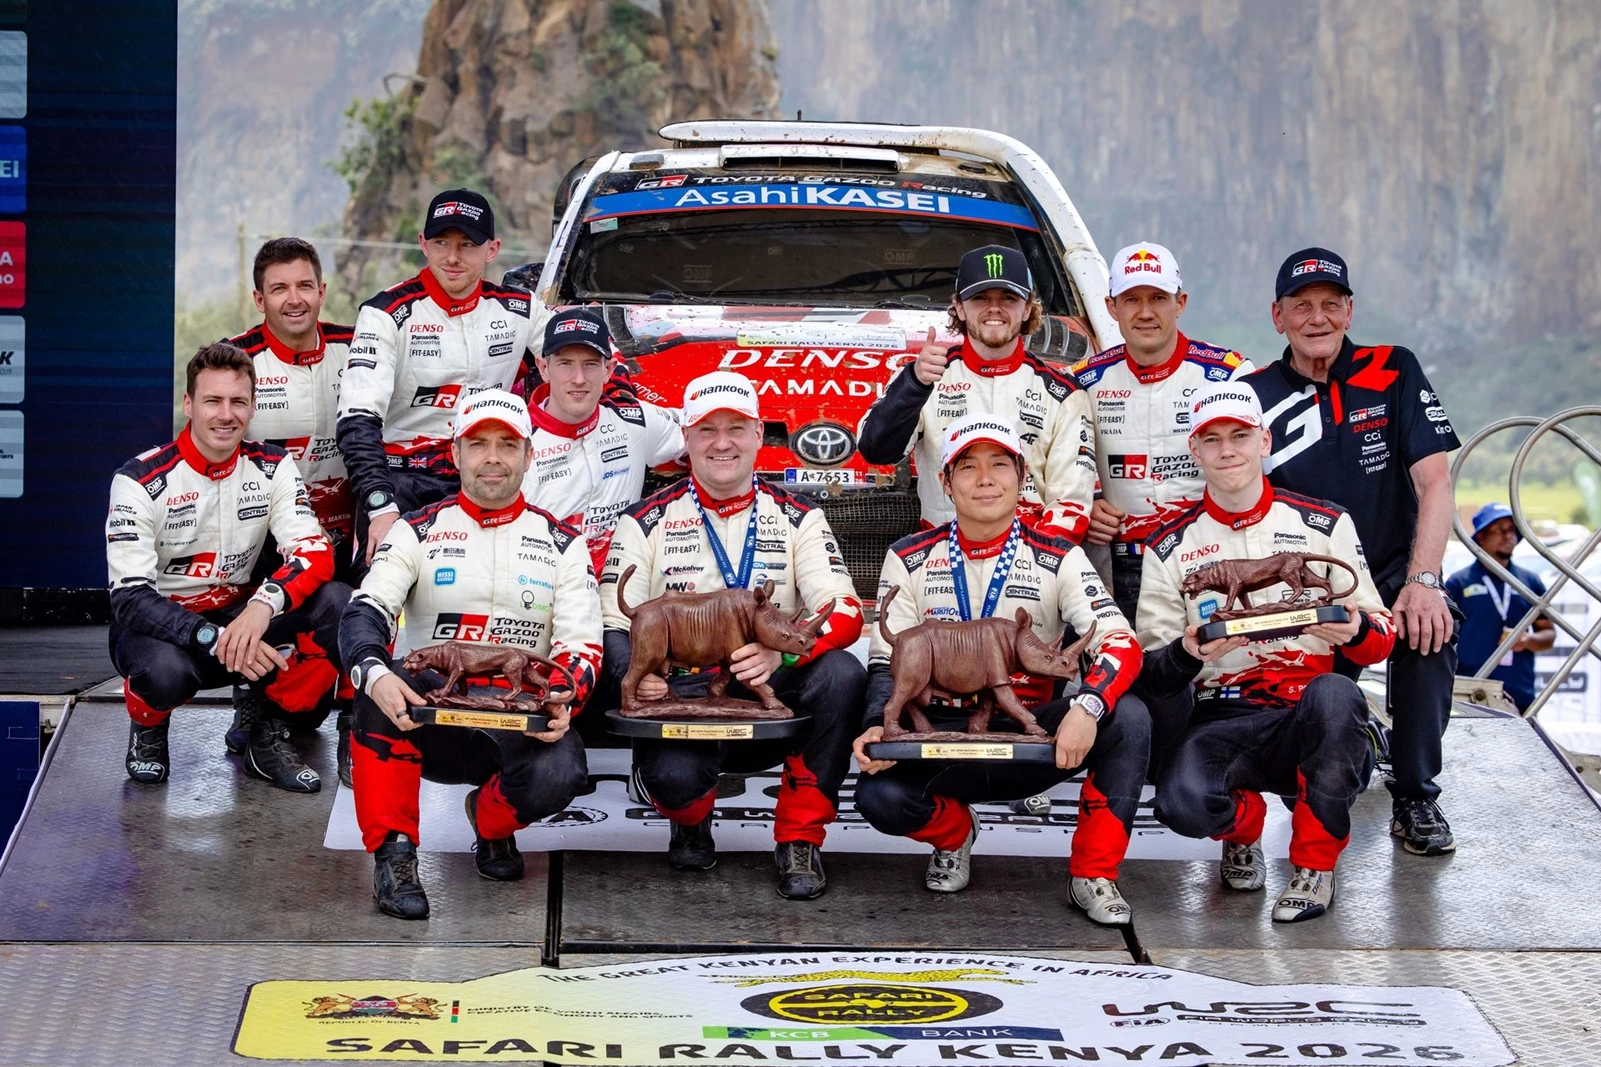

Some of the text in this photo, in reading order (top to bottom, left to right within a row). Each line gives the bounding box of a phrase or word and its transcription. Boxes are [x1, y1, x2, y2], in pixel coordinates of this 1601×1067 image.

[693, 175, 796, 185] TOYOTA
[802, 175, 896, 187] GAZOO
[901, 180, 987, 199] Racing
[434, 202, 457, 217] GR
[457, 206, 481, 217] GAZOO
[458, 202, 484, 213] TOYOTA
[883, 252, 915, 263] OMP
[1124, 263, 1162, 275] Red Bull
[1293, 262, 1317, 276] GR
[1318, 259, 1342, 270] TOYOTA
[508, 301, 528, 310] OMP
[394, 306, 409, 322] OMP
[409, 324, 444, 333] DENSO
[490, 320, 508, 330] CCi
[555, 320, 577, 334] GR
[484, 331, 517, 342] TAMADIC
[488, 344, 514, 356] CENTRAL
[717, 350, 919, 371] DENSO
[1079, 371, 1097, 385] OMP
[1209, 369, 1228, 380] OMP
[937, 382, 972, 394] DENSO
[1096, 389, 1131, 398] DENSO
[411, 393, 458, 408] GR
[618, 407, 642, 417] OMP
[1353, 417, 1388, 434] DENSO
[1364, 429, 1382, 442] CCi
[532, 442, 572, 460] DENSO
[1361, 441, 1386, 451] Panasonic
[536, 454, 568, 467] Panasonic
[536, 460, 569, 472] AUTOMOTIVE
[1109, 463, 1147, 479] GR
[1150, 470, 1199, 482] Racing
[147, 478, 163, 495] OMP
[242, 481, 260, 492] CCi
[166, 492, 199, 506] DENSO
[166, 510, 197, 519] AUTOMOTIVE
[168, 503, 196, 514] Panasonic
[238, 507, 269, 519] CENTRAL
[327, 514, 351, 523] MARTIN
[483, 517, 498, 525] GR
[643, 507, 662, 527] OMP
[1307, 514, 1331, 527] OMP
[664, 517, 704, 530] DENSO
[426, 531, 468, 544] DENSO
[665, 528, 699, 537] Panasonic
[665, 534, 700, 542] AUTOMOTIVE
[1273, 532, 1307, 540] Panasonic
[1159, 534, 1178, 553] OMP
[906, 552, 926, 566] OMP
[1180, 543, 1220, 563] DENSO
[517, 553, 557, 568] TAMADIC
[925, 558, 950, 569] DEN
[1014, 558, 1032, 571] CCi
[1038, 555, 1058, 568] OMP
[164, 560, 214, 578] GR
[1005, 588, 1041, 599] CENTRAL
[494, 616, 545, 631] TOYOTA
[433, 622, 485, 642] GR
[492, 627, 540, 638] GAZOO
[487, 635, 538, 648] Racing
[1197, 689, 1215, 699] OMP
[536, 956, 1174, 983] THE GREAT KENYAN EXPERIENCE IN AFRICA
[804, 992, 934, 1000] SAFARI
[818, 1009, 926, 1017] RALLY
[1112, 1018, 1168, 1028] FIA
[769, 1028, 1014, 1038] KCB BANK
[326, 1037, 1465, 1061] SAFARI RALLY KENYA 2026
